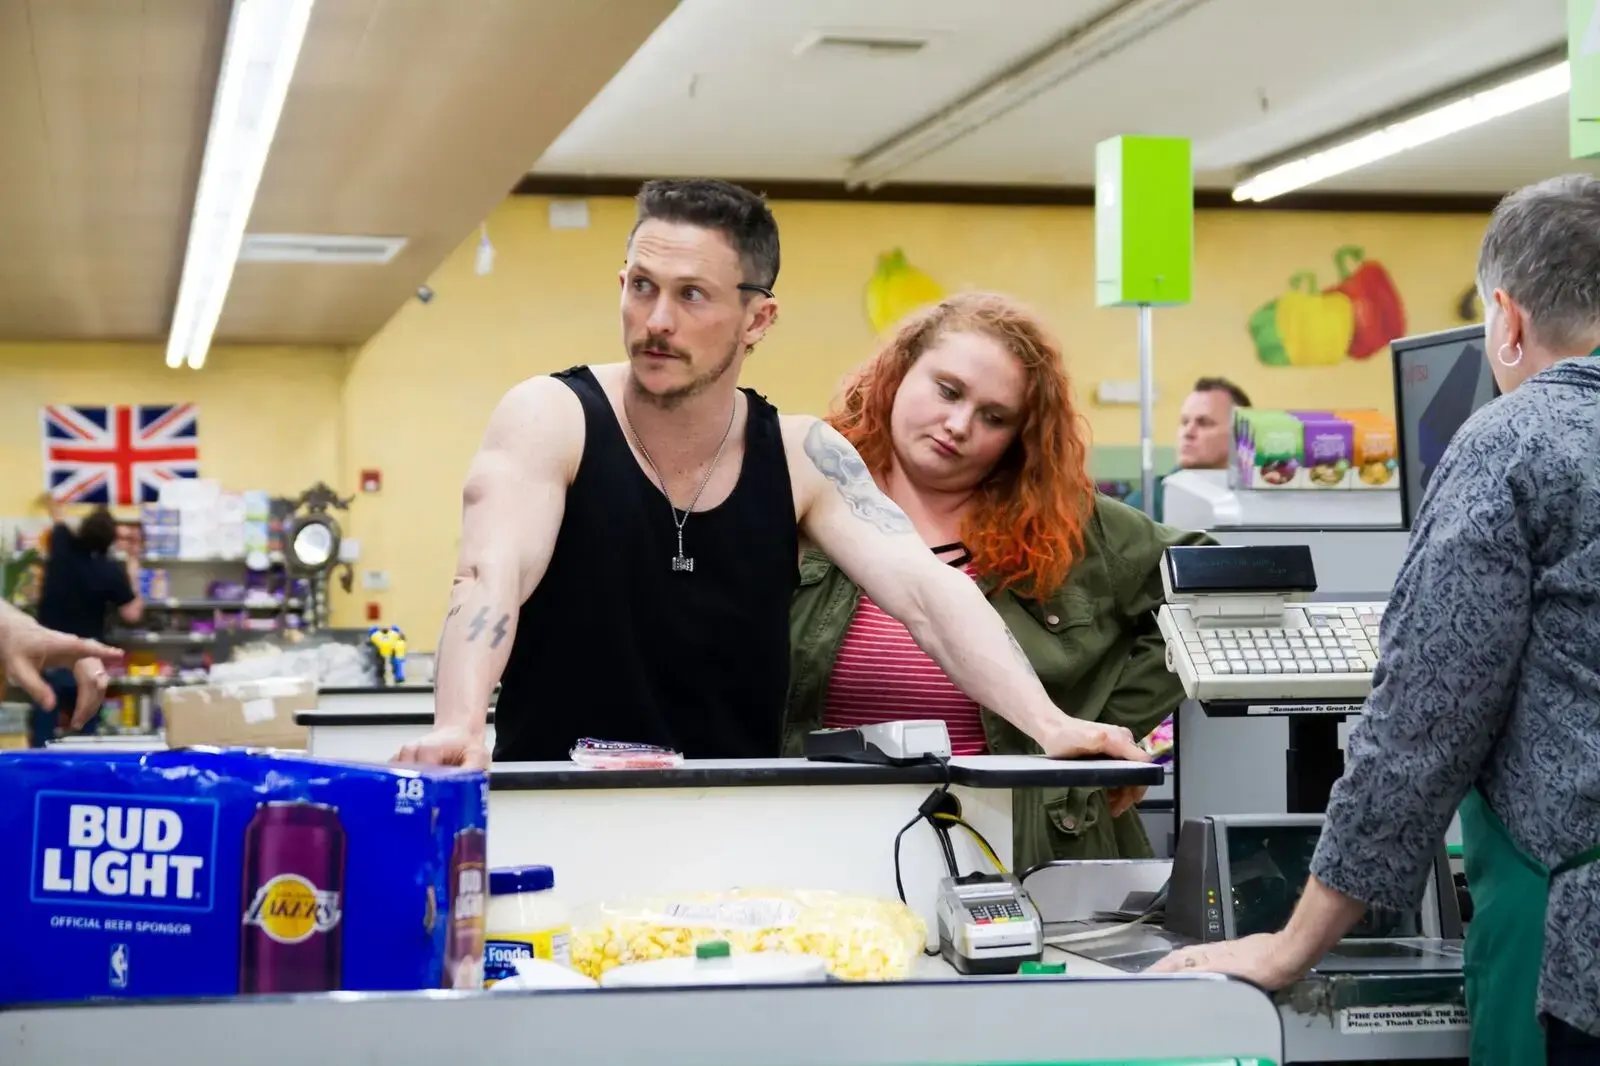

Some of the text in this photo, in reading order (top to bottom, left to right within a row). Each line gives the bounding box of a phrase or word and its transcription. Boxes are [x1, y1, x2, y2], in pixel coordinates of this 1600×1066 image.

[395, 778, 425, 800] 18
[68, 804, 183, 852] BUD
[42, 848, 204, 899] LIGHT
[50, 915, 192, 934] OFFICIAL BEER SPONSOR
[488, 947, 531, 962] Foods
[1386, 1019, 1413, 1027] Thank
[1417, 1018, 1445, 1026] Check
[1435, 1009, 1452, 1018] THE
